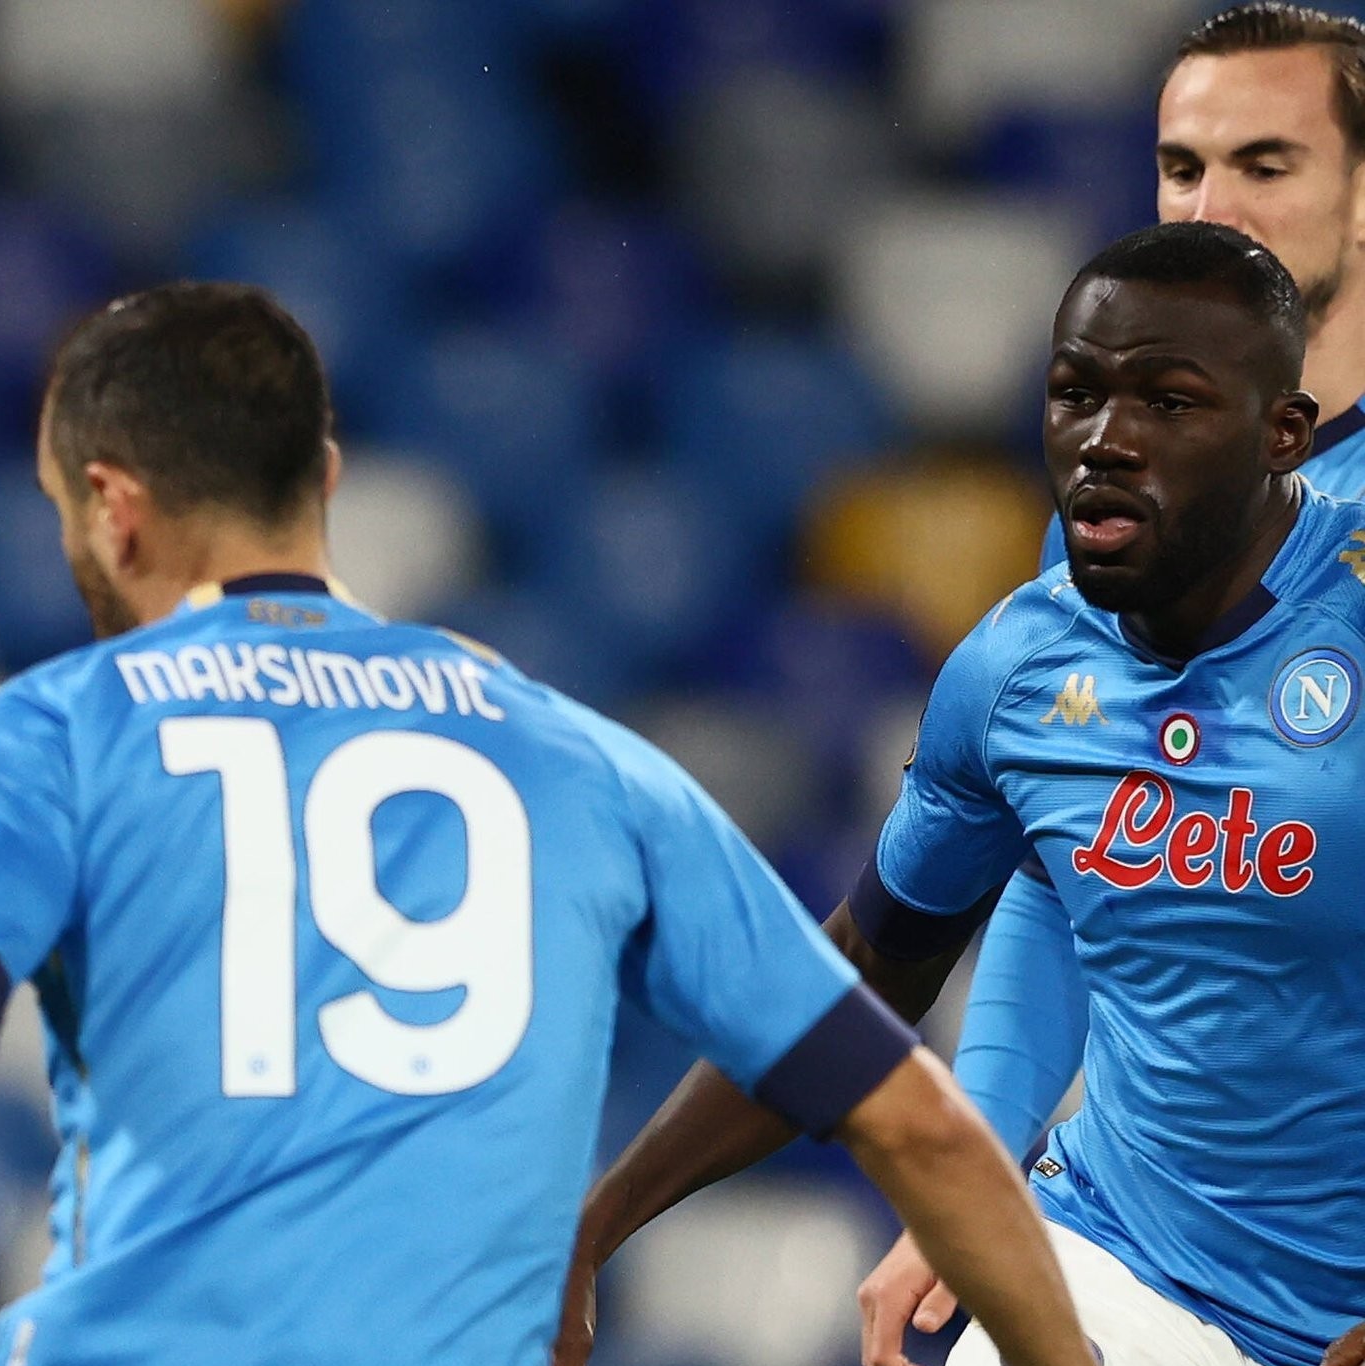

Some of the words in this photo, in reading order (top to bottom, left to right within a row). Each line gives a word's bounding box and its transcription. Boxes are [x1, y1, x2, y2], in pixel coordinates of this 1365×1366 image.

[1294, 674, 1338, 720] N
[1072, 769, 1317, 897] Lete
[158, 716, 533, 1097] 19
